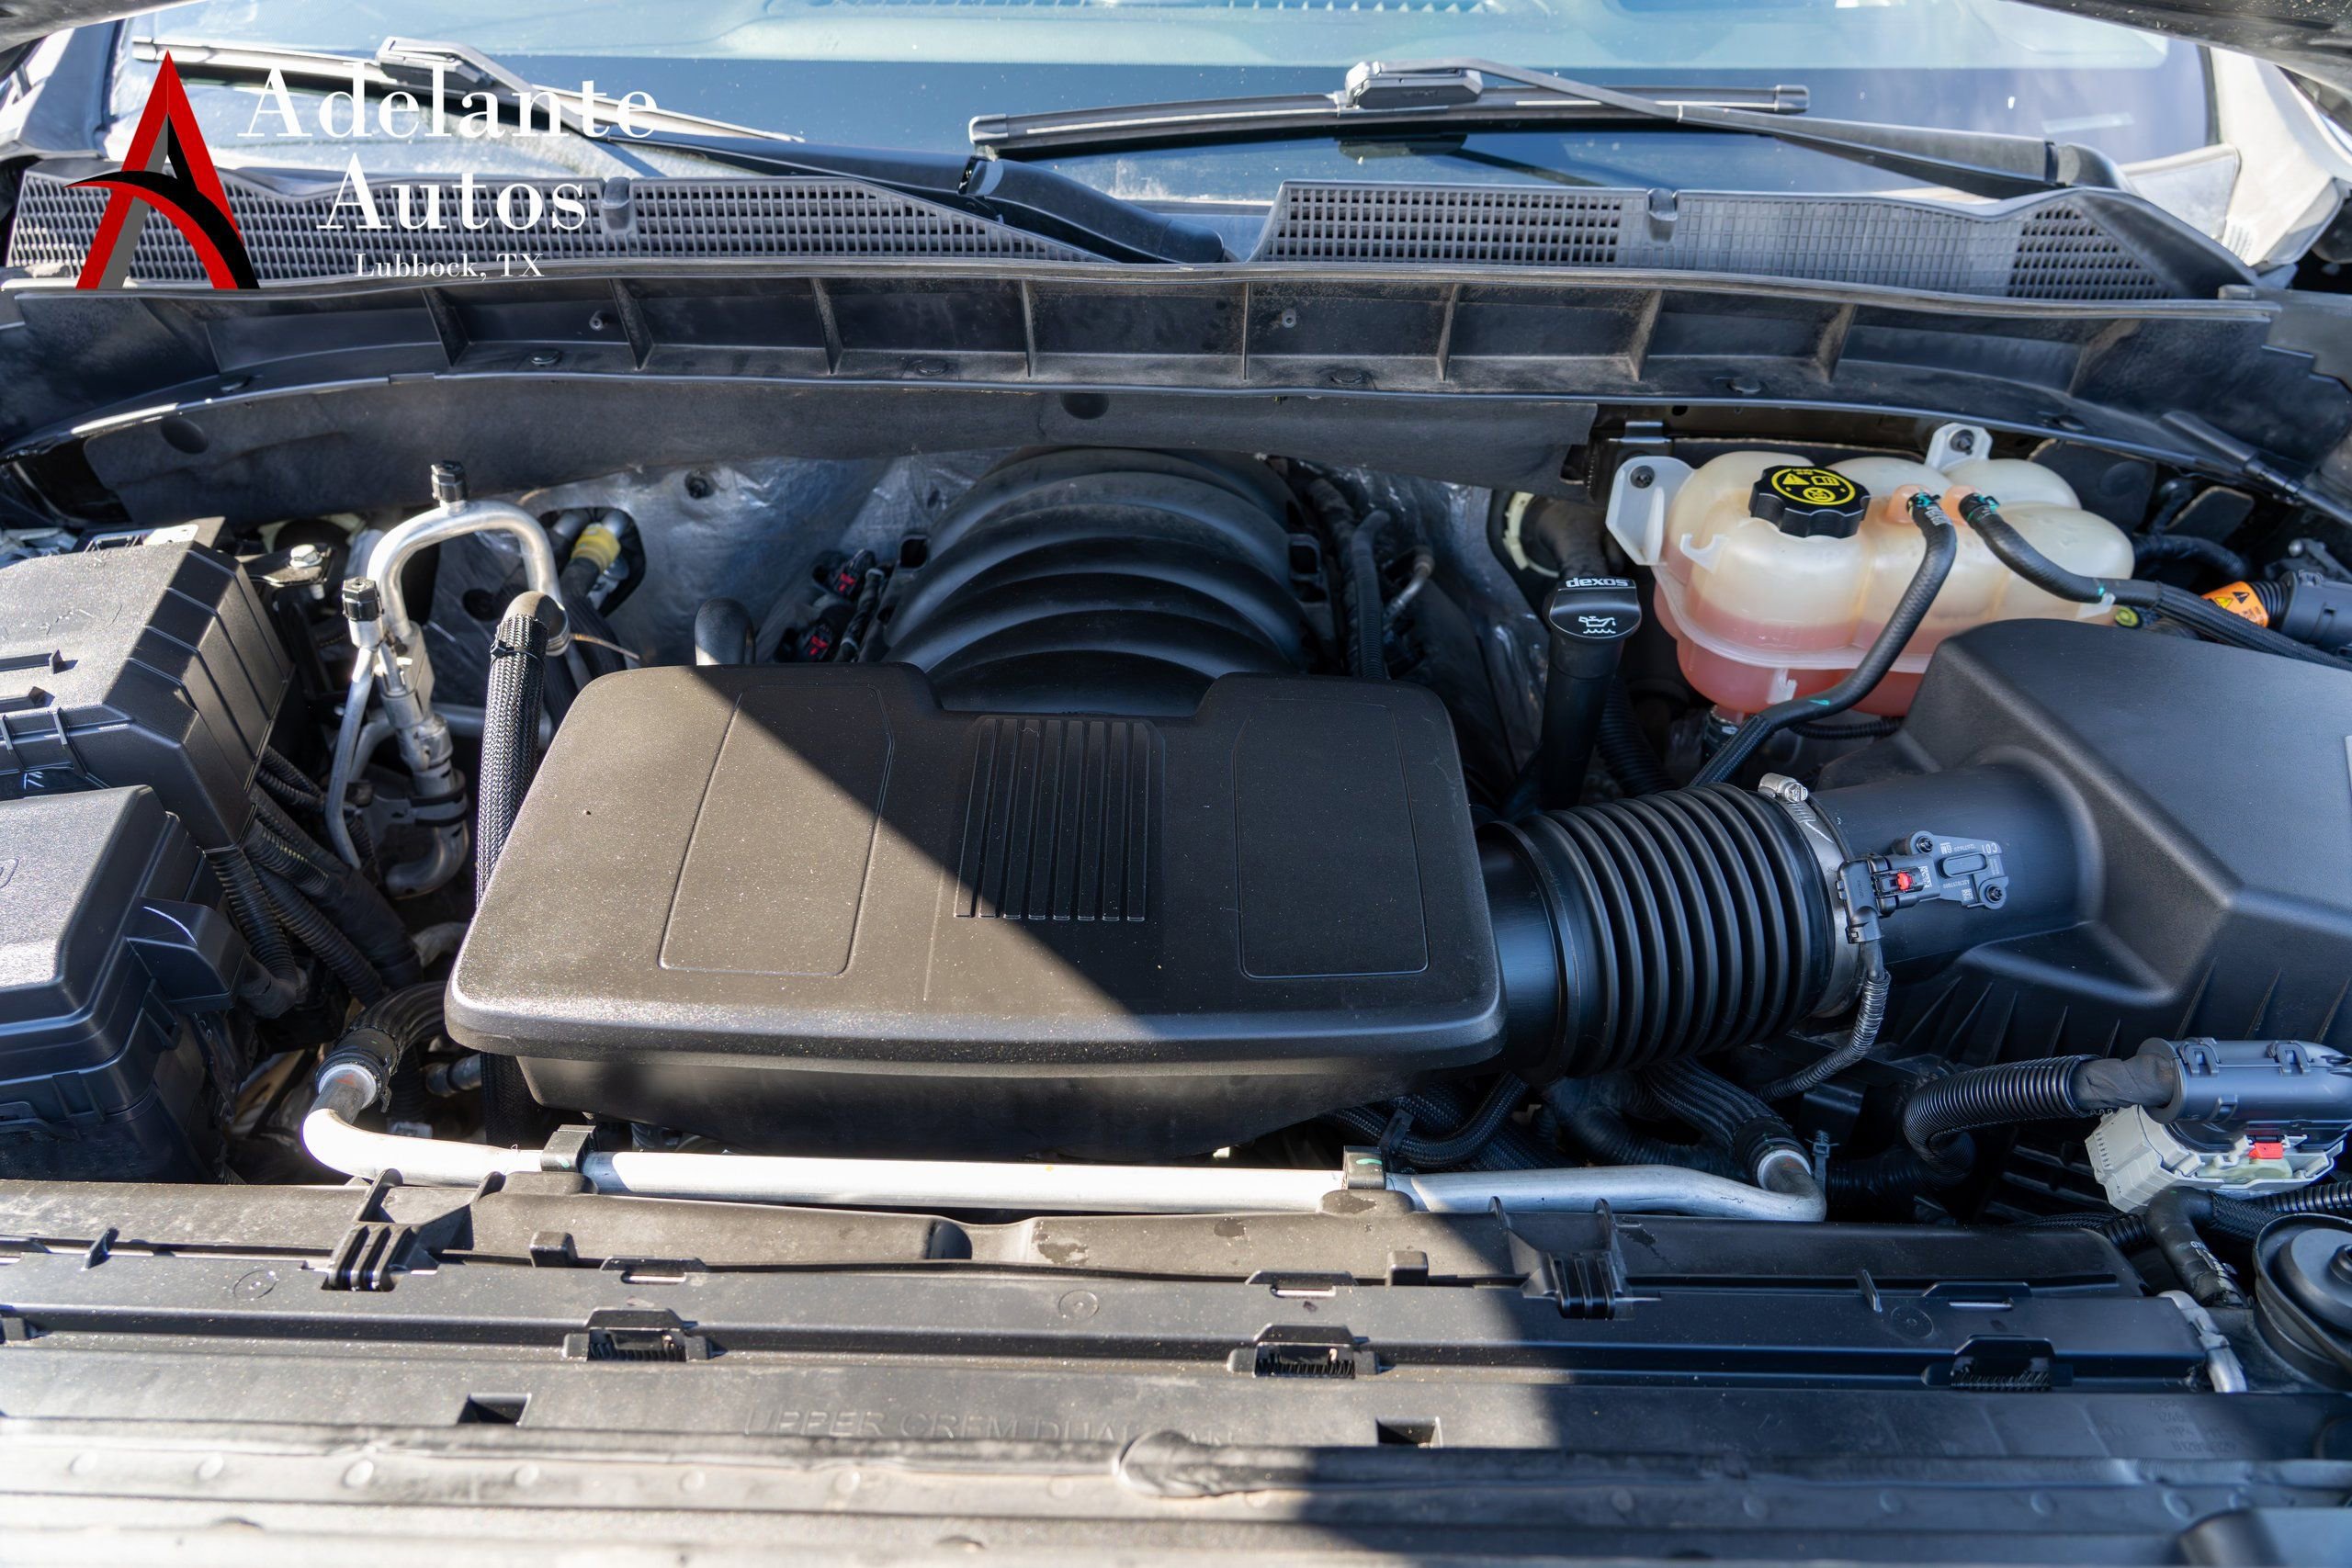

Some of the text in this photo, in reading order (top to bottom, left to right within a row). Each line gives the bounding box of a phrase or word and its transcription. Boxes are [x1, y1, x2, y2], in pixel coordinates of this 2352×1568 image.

[1565, 577, 1630, 588] dexos
[1939, 841, 1952, 854] GM
[744, 1407, 886, 1436] UPPER
